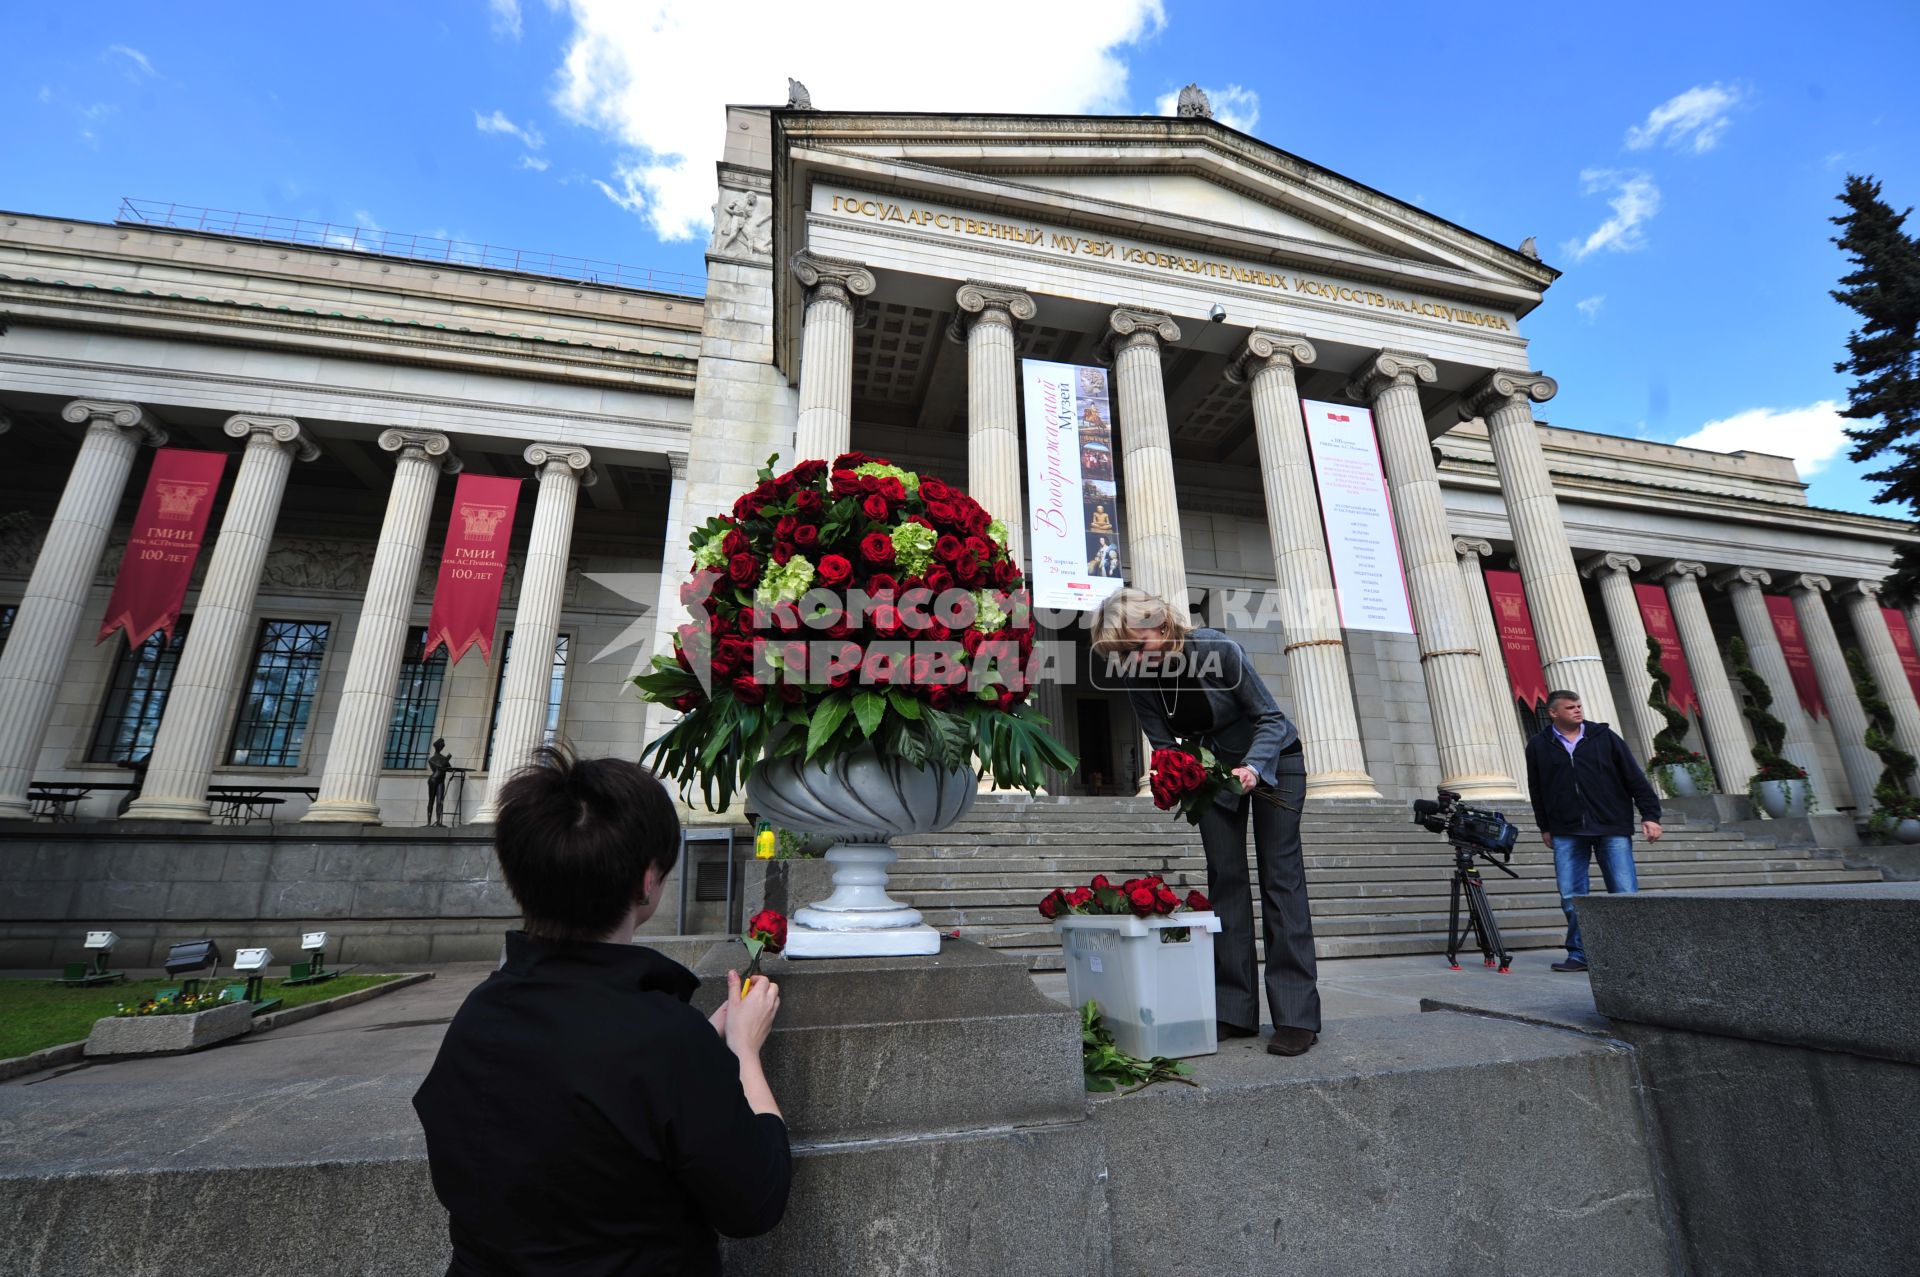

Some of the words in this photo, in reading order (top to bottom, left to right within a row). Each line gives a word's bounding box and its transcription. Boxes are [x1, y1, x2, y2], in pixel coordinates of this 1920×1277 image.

[832, 194, 1044, 247] ГОСУДАРСТВЕННЫЙ
[1052, 234, 1115, 260] МУЗЕЙ
[1122, 247, 1289, 290] ИЗОБРАЗИТЕЛЬНЫХ
[1295, 279, 1385, 308] ИСКУССТВ
[1058, 382, 1073, 431] Музей
[1033, 377, 1074, 538] Воображаемый
[147, 528, 193, 540] ГМИИ
[140, 549, 163, 560] 100
[455, 548, 495, 559] ГМИИ
[451, 569, 472, 579] 100
[1507, 642, 1520, 650] 100
